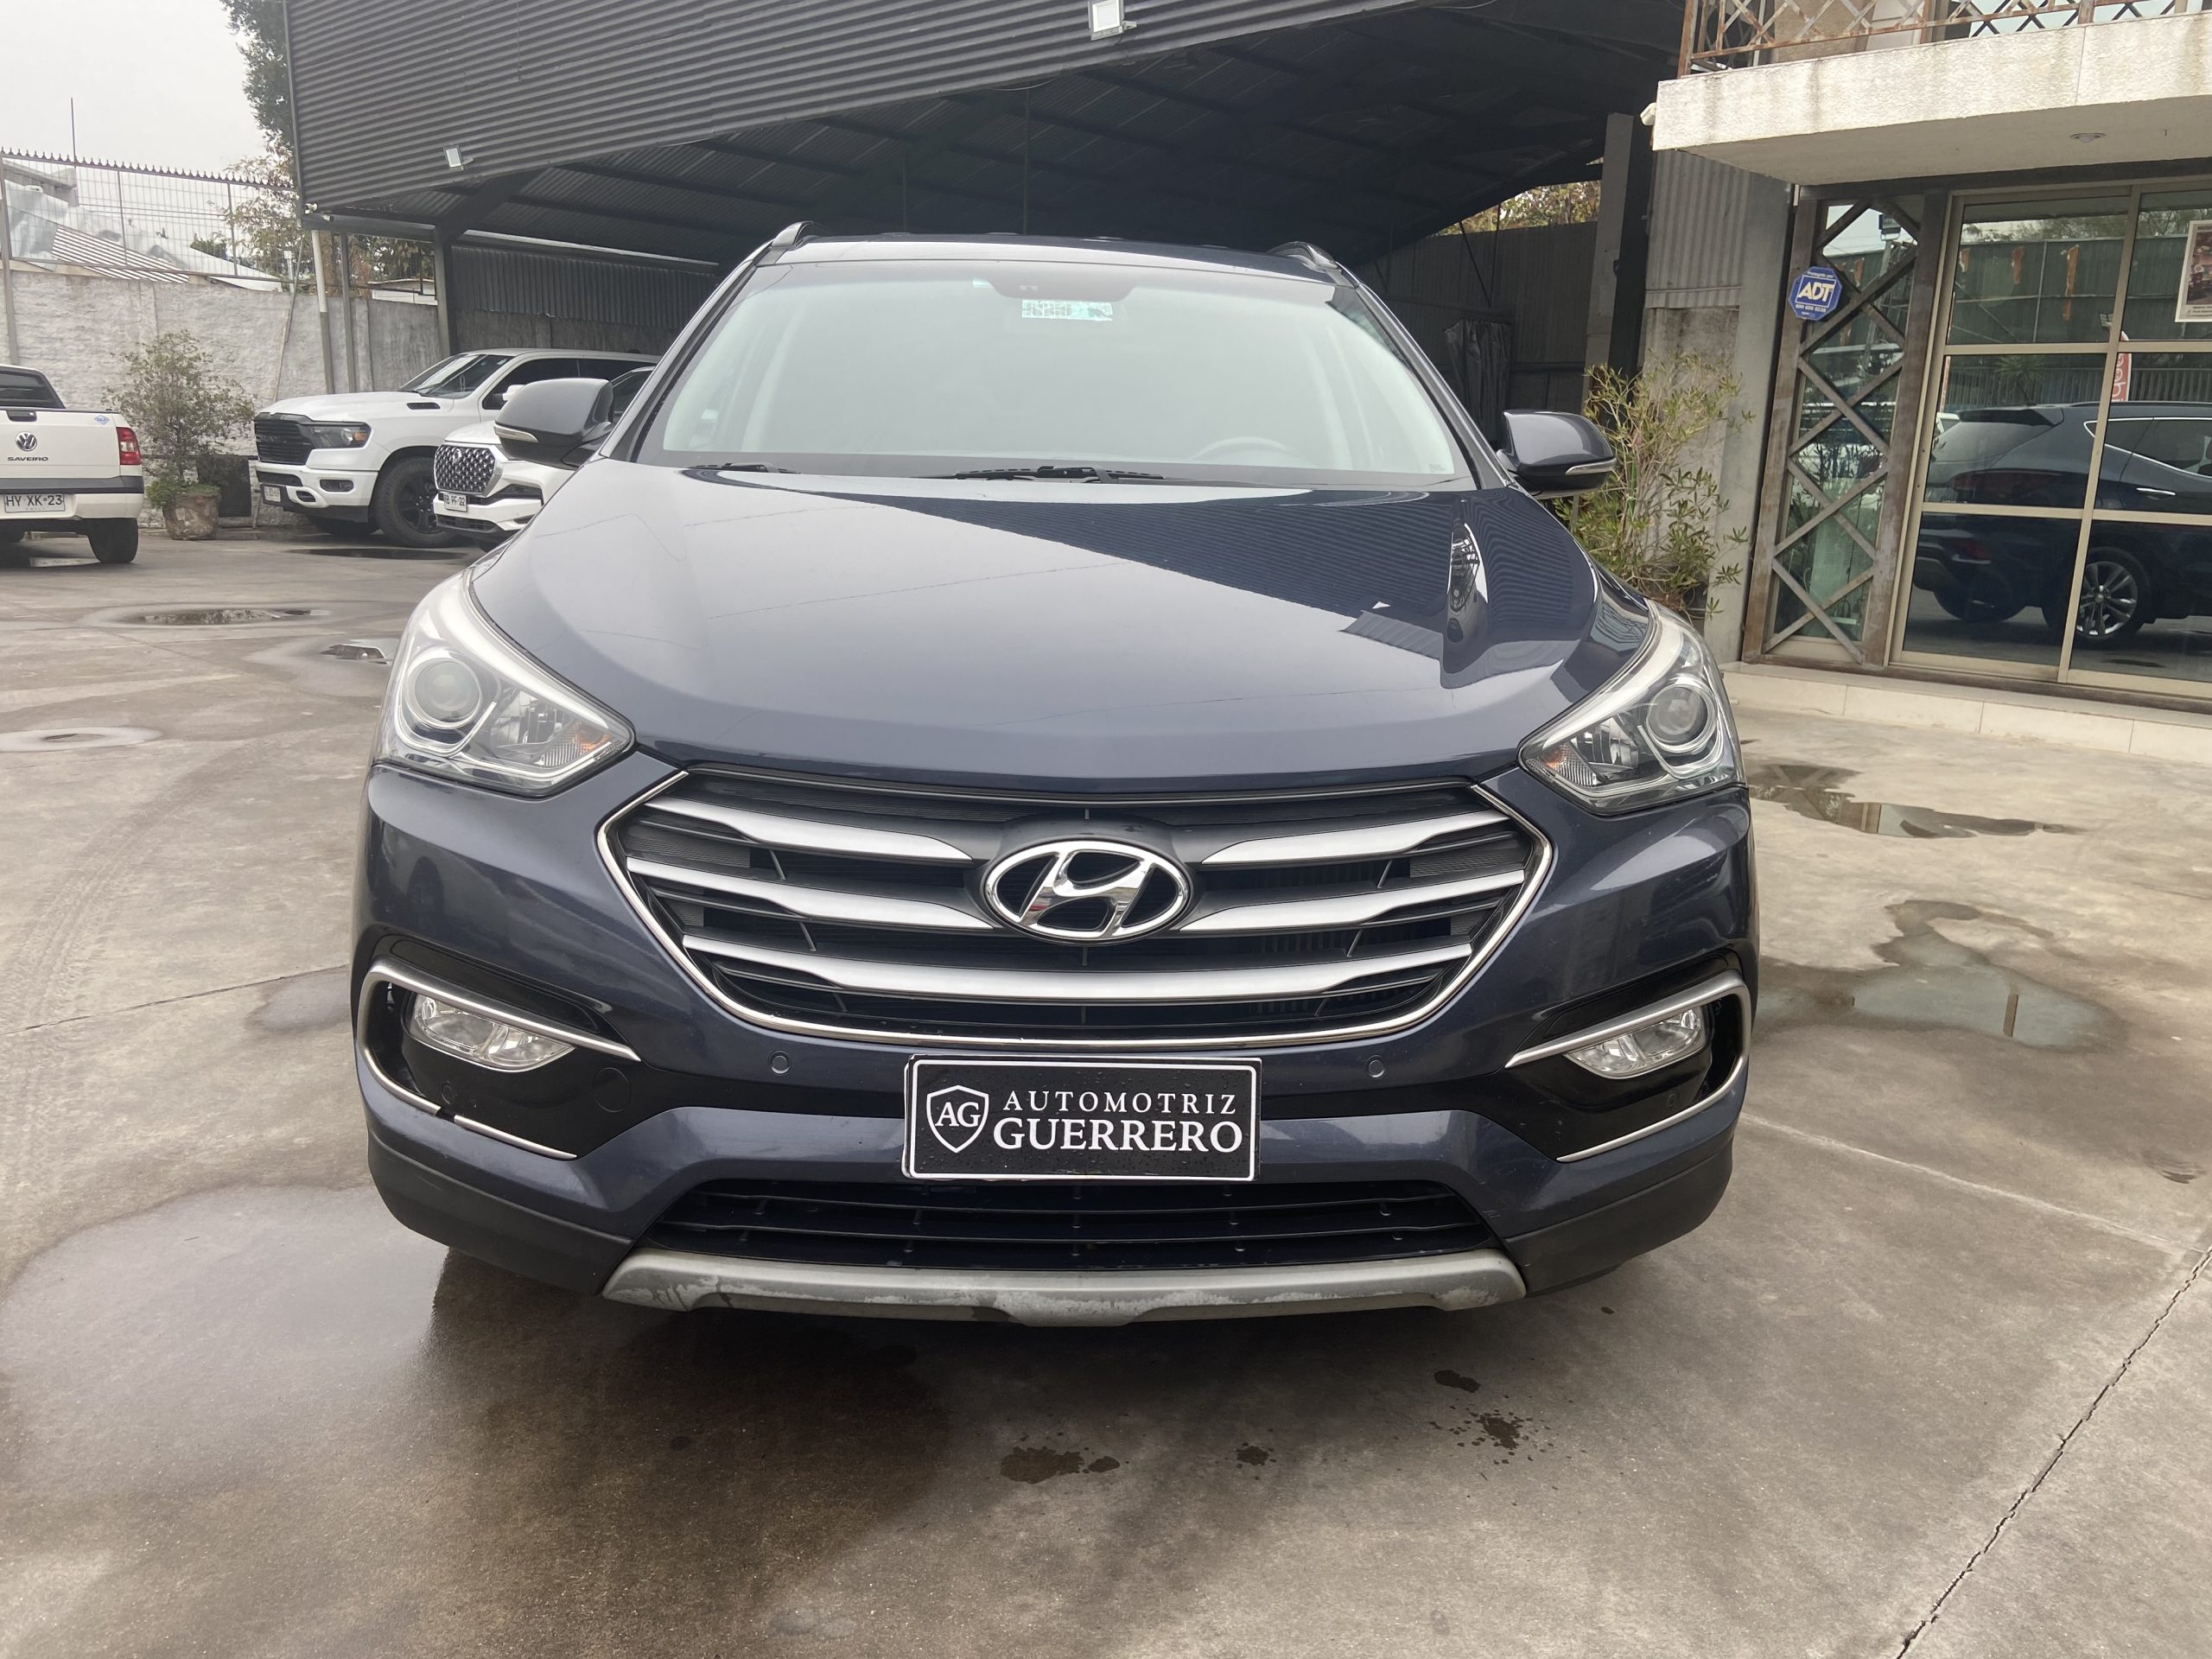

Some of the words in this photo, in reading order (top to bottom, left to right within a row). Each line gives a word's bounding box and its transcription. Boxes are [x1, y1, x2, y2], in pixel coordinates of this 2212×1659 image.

[1797, 281, 1834, 302] ADT
[934, 1101, 982, 1128] AG
[1001, 1090, 1236, 1115] AUTOMOTRIZ
[993, 1116, 1243, 1154] GUERRERO
